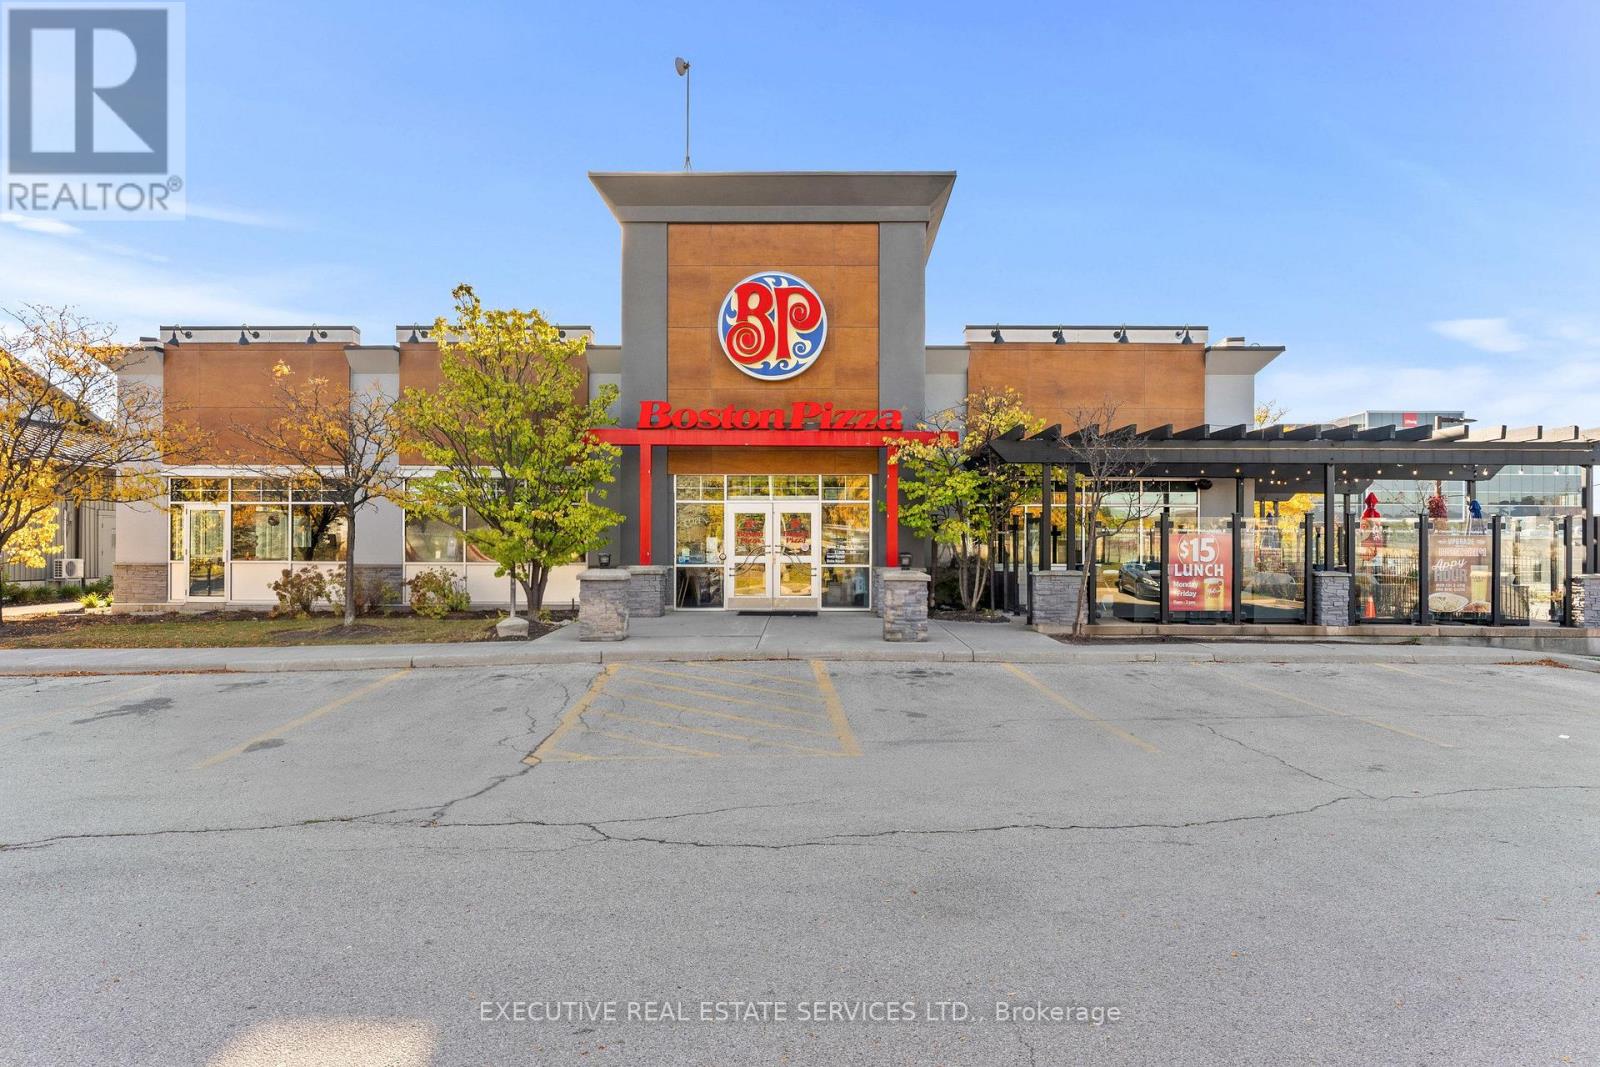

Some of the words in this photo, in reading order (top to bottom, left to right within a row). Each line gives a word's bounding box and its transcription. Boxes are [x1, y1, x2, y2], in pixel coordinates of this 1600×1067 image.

[726, 281, 822, 365] BP
[637, 400, 786, 430] Boston
[789, 401, 904, 430] Pizza
[1180, 537, 1216, 562] $15
[1174, 563, 1224, 577] LUNCH
[1173, 580, 1199, 590] Monday
